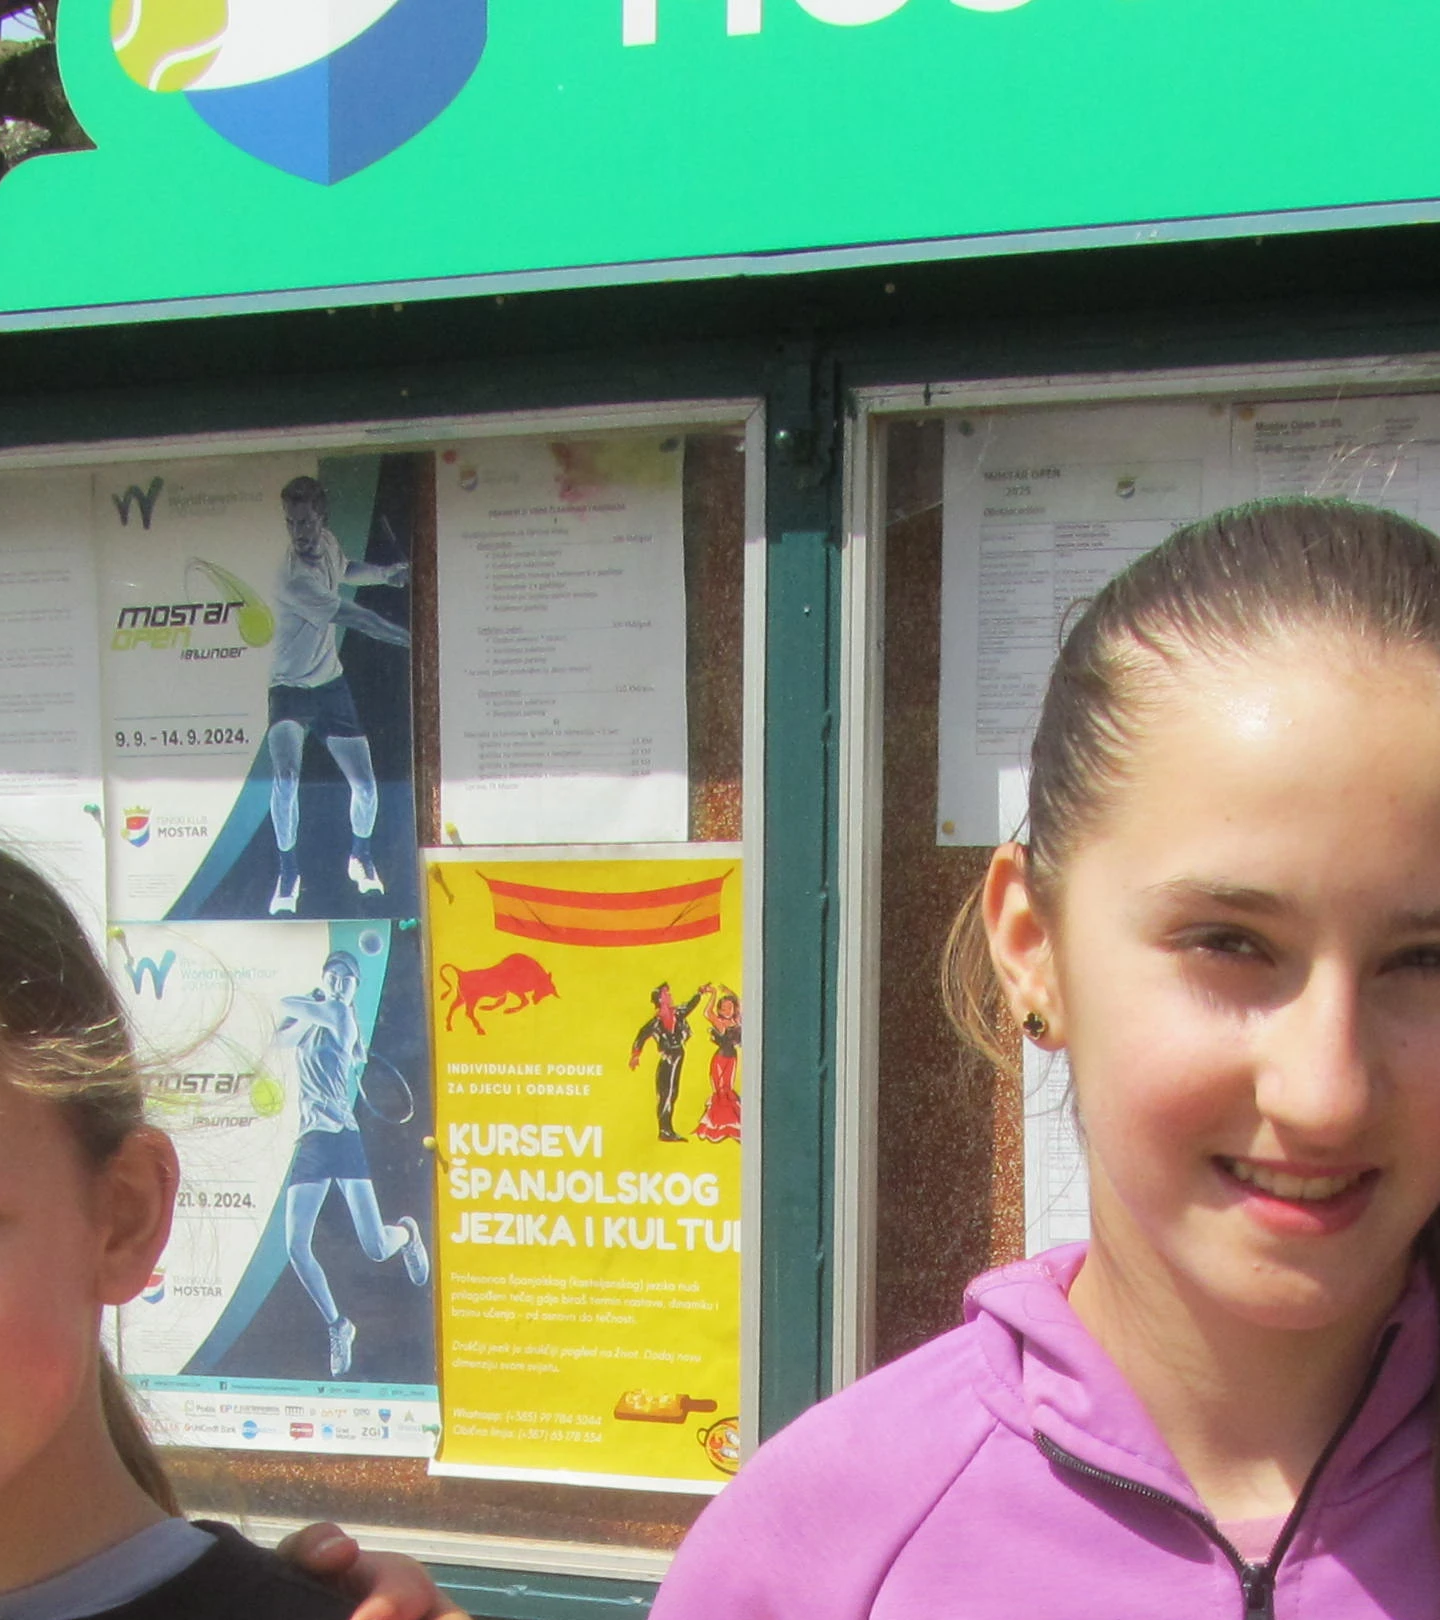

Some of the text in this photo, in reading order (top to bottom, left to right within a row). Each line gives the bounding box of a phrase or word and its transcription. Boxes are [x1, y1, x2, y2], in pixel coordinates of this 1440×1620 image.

[158, 827, 208, 838] MOSTAR
[447, 1063, 603, 1077] INDIVIDUALNE PODUKE
[448, 1083, 464, 1094] ZA
[470, 1083, 511, 1095] DJECU
[526, 1084, 590, 1096] ODRASLE
[448, 1123, 602, 1158] KURSEVI
[449, 1158, 719, 1207] ŠPANJOLSKOG
[451, 1212, 576, 1247] JEZIKA
[585, 1216, 594, 1247] I
[173, 1286, 222, 1297] MOSTAR
